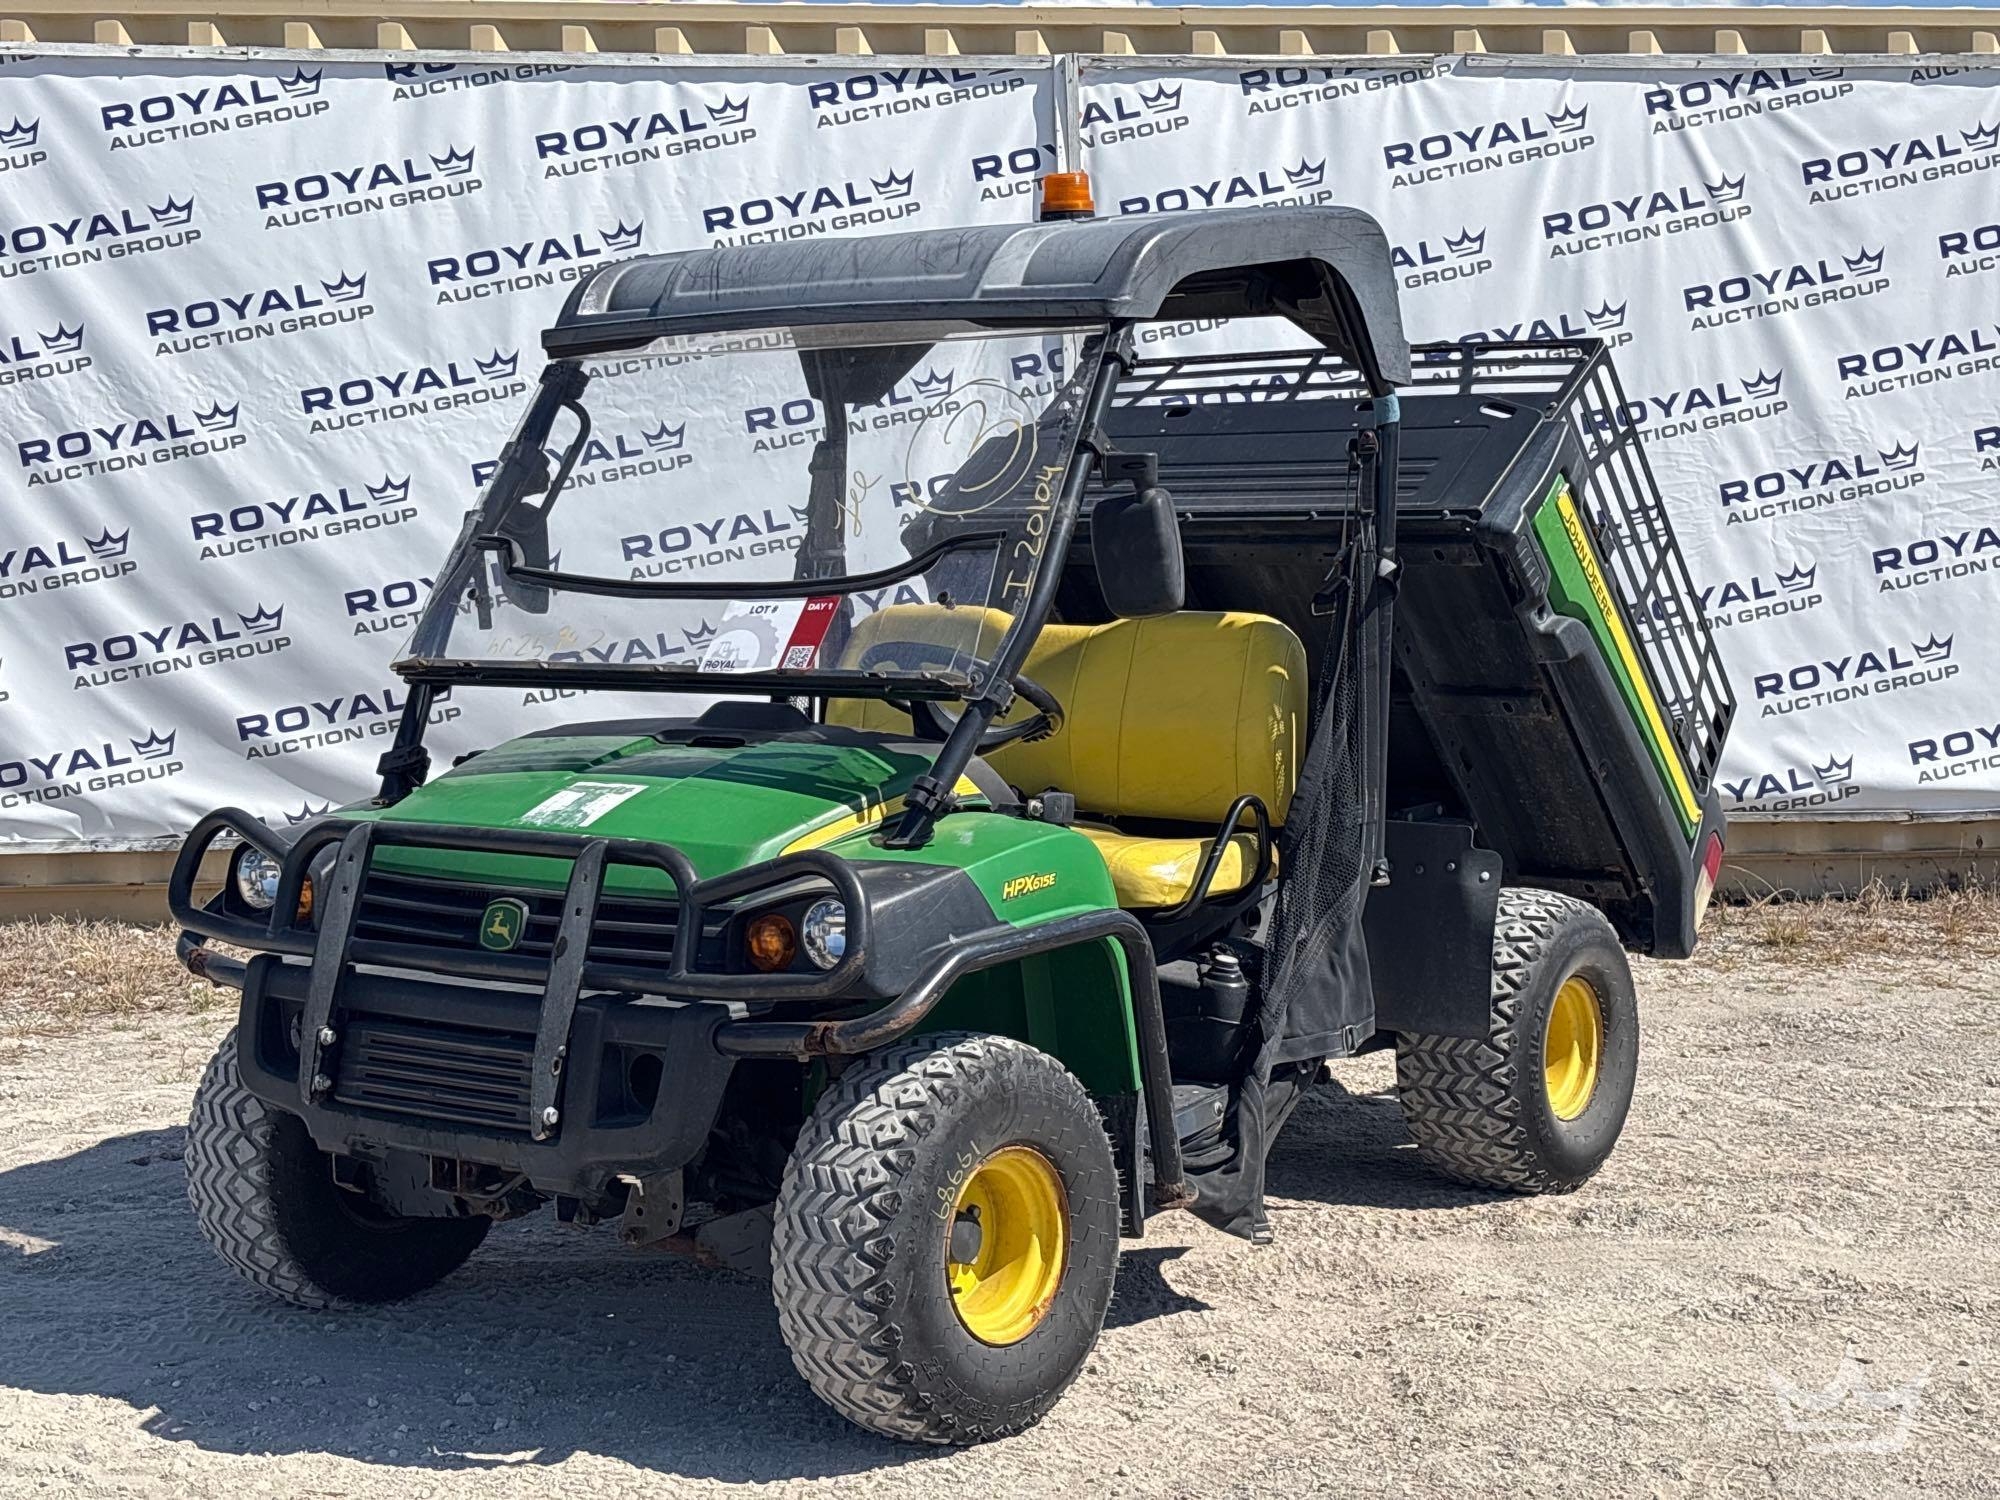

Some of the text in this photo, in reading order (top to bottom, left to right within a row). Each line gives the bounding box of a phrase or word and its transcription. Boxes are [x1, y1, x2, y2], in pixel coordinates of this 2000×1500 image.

[101, 80, 278, 130] ROYAL
[393, 69, 509, 100] AUCTION
[809, 68, 977, 109] ROYAL
[817, 77, 1024, 128] AUCTION GROUP
[1248, 82, 1359, 115] AUCTION
[1365, 63, 1452, 91] GROUP
[1644, 68, 1807, 115] ROYAL
[1652, 83, 1853, 133] AUCTION GROUP
[110, 100, 329, 151] AUCTION GROUP
[536, 109, 707, 159] ROYAL
[1101, 116, 1188, 144] GROUP
[1384, 117, 1548, 168] ROYAL
[544, 128, 756, 179] AUCTION GROUP
[1392, 135, 1594, 188] AUCTION GROUP
[1802, 135, 1961, 185] ROYAL
[256, 159, 432, 209] ROYAL
[265, 179, 482, 229] AUCTION GROUP
[703, 183, 872, 232] ROYAL
[1810, 172, 1917, 204] AUCTION
[0, 210, 151, 260] OYAL
[712, 202, 920, 248] AUCTION GROUP
[1543, 187, 1705, 238] ROYAL
[1551, 205, 1752, 257] AUCTION GROUP
[0, 230, 201, 277] UCTION GROUP
[428, 234, 601, 284] ROYAL
[1406, 260, 1491, 287] GROUP
[147, 285, 323, 336] ROYAL
[437, 272, 553, 304] AUCTION
[1683, 260, 1844, 311] ROYAL
[1691, 278, 1889, 330] AUCTION GROUP
[156, 305, 373, 356] AUCTION GROUP
[1142, 318, 1229, 342] GROUP
[1837, 330, 1996, 380] ROYAL
[0, 357, 92, 385] GROUP
[301, 363, 476, 413] ROYAL
[1845, 367, 1952, 398] AUCTION
[310, 382, 526, 433] AUCTION GROUP
[873, 401, 960, 429] GROUP
[1703, 401, 1788, 429] GROUP
[18, 415, 195, 466] ROYAL
[27, 434, 246, 486] AUCTION GROUP
[602, 454, 692, 482] GROUP
[1719, 455, 1879, 506] ROYAL
[191, 488, 367, 540] ROYAL
[1727, 472, 1925, 525] AUCTION GROUP
[200, 507, 417, 560] AUCTION GROUP
[621, 509, 791, 560] ROYAL
[1872, 528, 2000, 573] ROYA
[43, 561, 136, 589] GROUP
[630, 547, 743, 580] AUCTION
[1564, 512, 1613, 622] JOHN DEERE
[1880, 559, 1987, 592] AUCTION
[749, 605, 771, 614] LOT
[807, 602, 826, 611] DAY
[1738, 594, 1822, 622] GROUP
[65, 617, 241, 669] ROYAL
[74, 636, 291, 689] AUCTION GROUP
[1754, 648, 1913, 698] ROYAL
[1762, 664, 1959, 716] AUCTION GROUP
[237, 688, 406, 741] ROYAL
[0, 743, 132, 788] OYAL
[246, 727, 363, 760] AUCTION
[1909, 723, 2000, 764] ROY
[0, 762, 182, 808] CTION GROUP
[1775, 785, 1859, 812] GROUP
[1002, 871, 1057, 901] HPX615E
